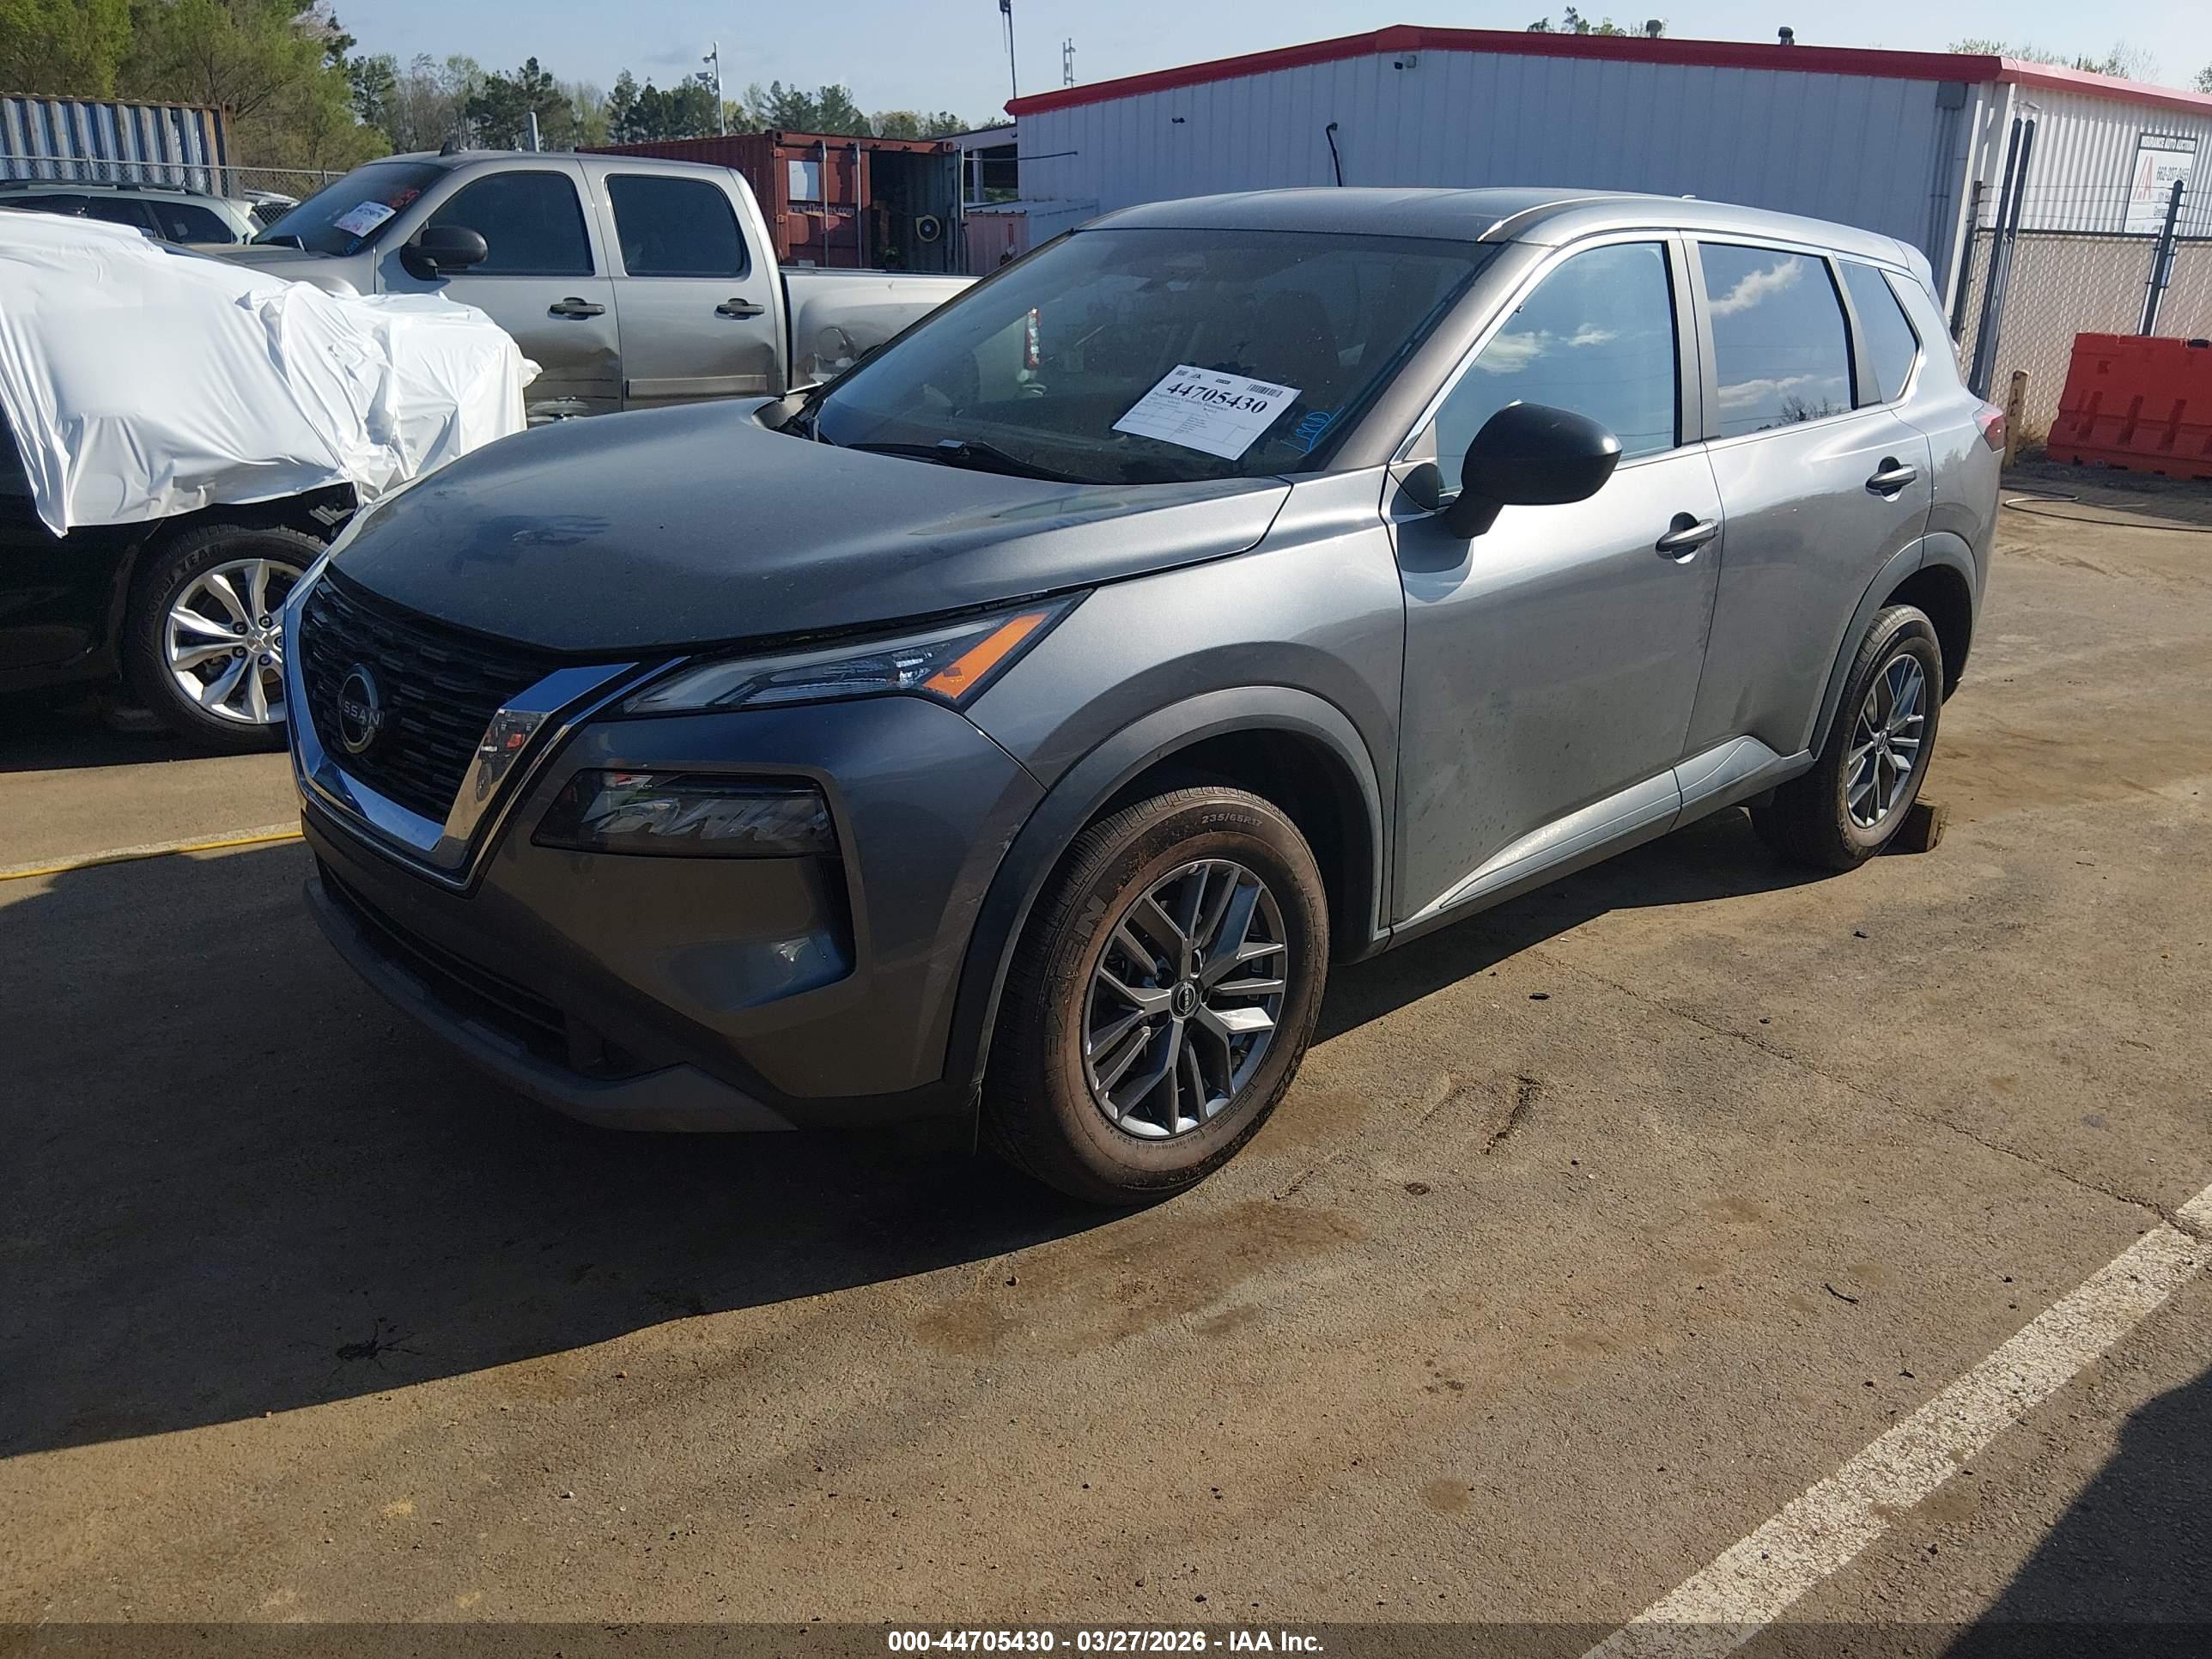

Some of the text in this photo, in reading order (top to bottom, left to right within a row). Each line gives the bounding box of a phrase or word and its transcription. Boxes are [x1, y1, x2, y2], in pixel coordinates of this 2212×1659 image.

[788, 203, 854, 216] www.florns.com
[1166, 382, 1268, 414] 44705430
[339, 699, 381, 726] SSAN
[1201, 812, 1264, 828] 235/65R17
